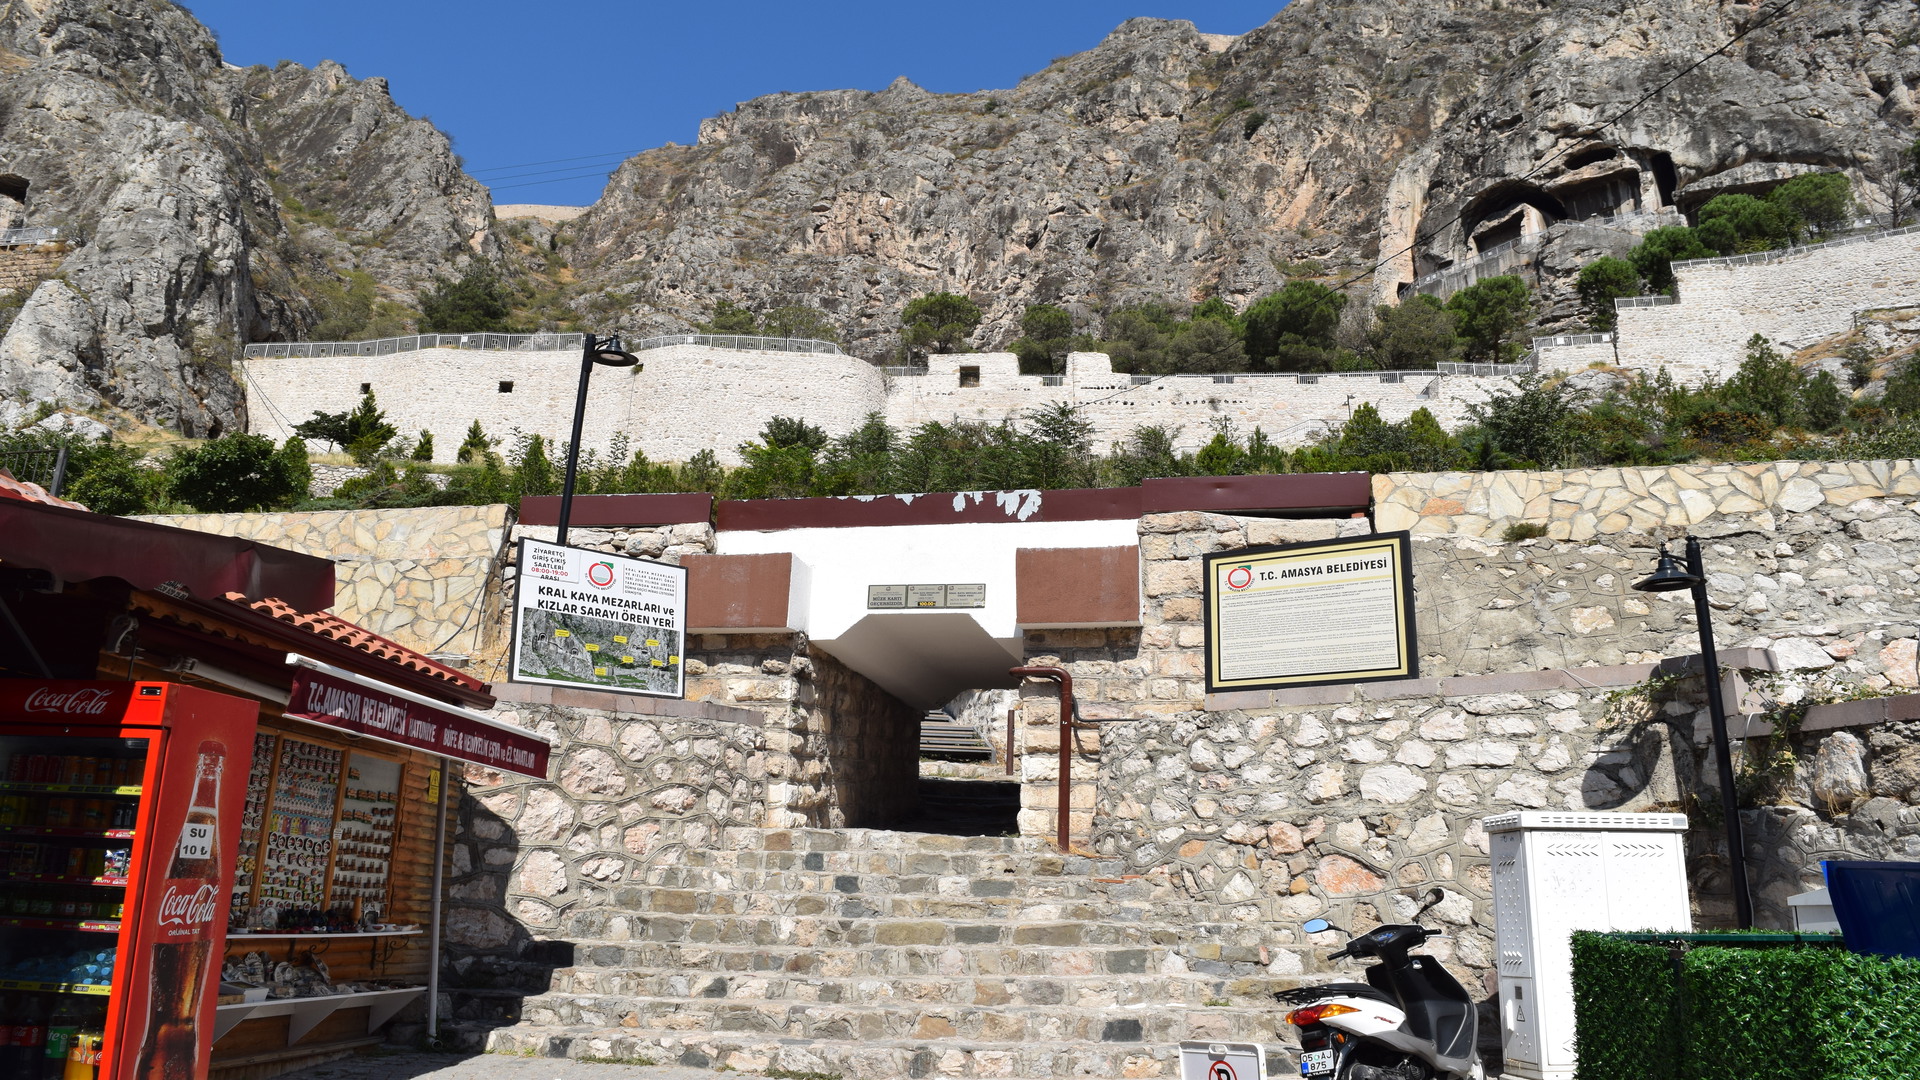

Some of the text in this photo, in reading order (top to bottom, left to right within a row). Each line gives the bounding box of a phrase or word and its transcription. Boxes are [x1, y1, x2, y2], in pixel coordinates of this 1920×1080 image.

[534, 547, 565, 557] ZİYARETÇİ
[534, 562, 564, 570] SAATLERİ
[550, 557, 566, 565] ÇIKIŞ
[531, 567, 569, 577] 08:00-19:00
[1260, 557, 1387, 581] T.C. AMASYA BELEDİYESİ
[538, 585, 674, 616] KRAL KAYA MEZARLARI ve
[538, 599, 674, 628] KIZLAR SARAYI ÖREN YERİ
[307, 682, 535, 769] T.C.AMASYA BELEDİYESİ HATUNİYE BÜFE & HEDİYELİK EŞYA ve EL SANATLARI
[190, 828, 206, 838] SU
[183, 845, 197, 855] 10
[158, 884, 219, 926] Coca-Cola
[1302, 1051, 1331, 1062] 05 AJ
[1310, 1061, 1326, 1070] 875
